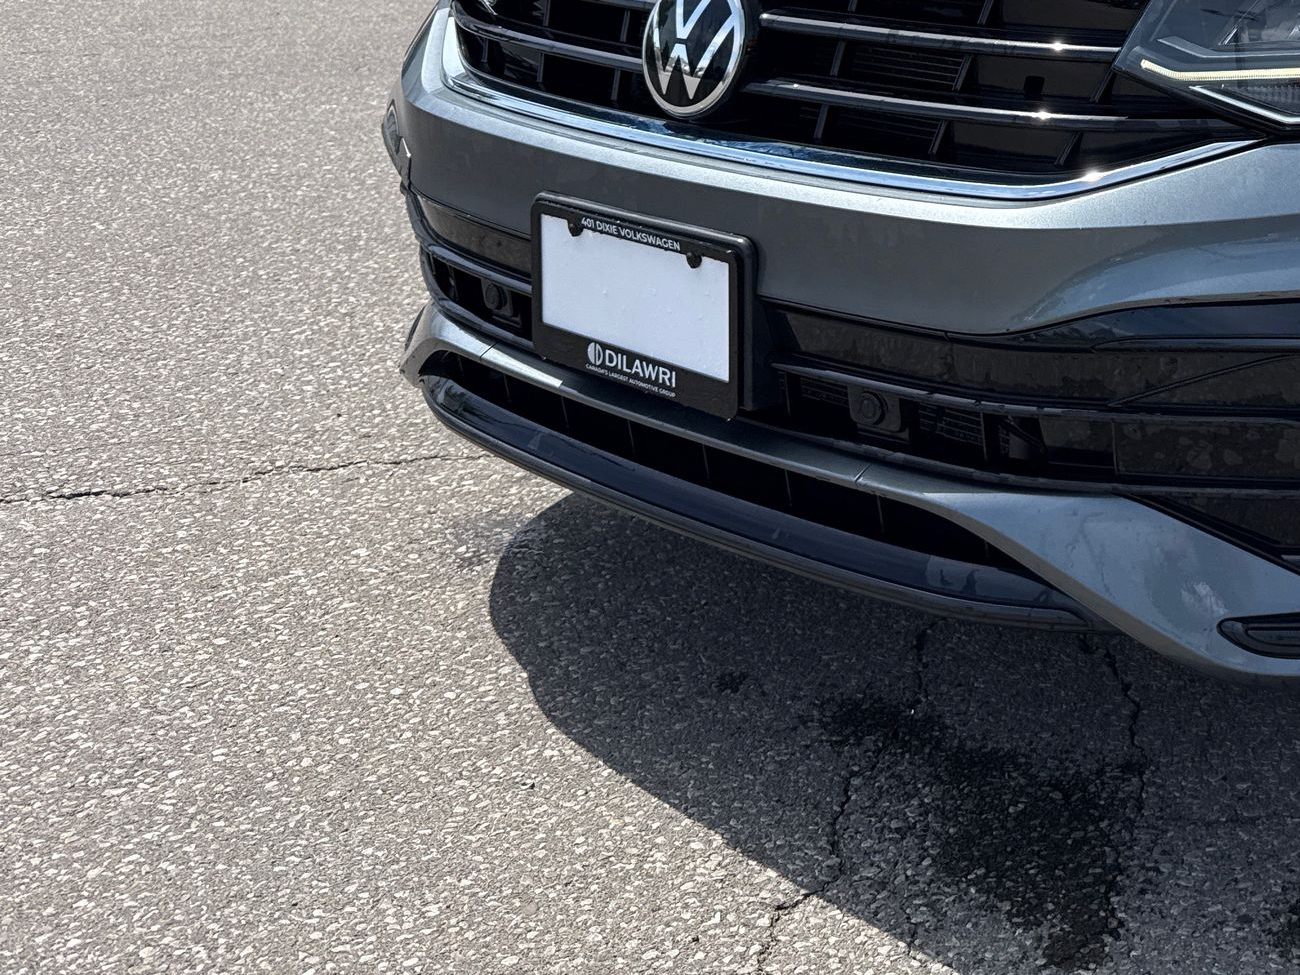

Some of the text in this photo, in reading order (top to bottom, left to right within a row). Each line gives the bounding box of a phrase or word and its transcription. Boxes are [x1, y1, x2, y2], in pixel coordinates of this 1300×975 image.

[581, 217, 681, 251] 401 DIXIE VOLKSWAGEN
[605, 349, 676, 388] DILAWRI
[659, 387, 676, 398] GROUP
